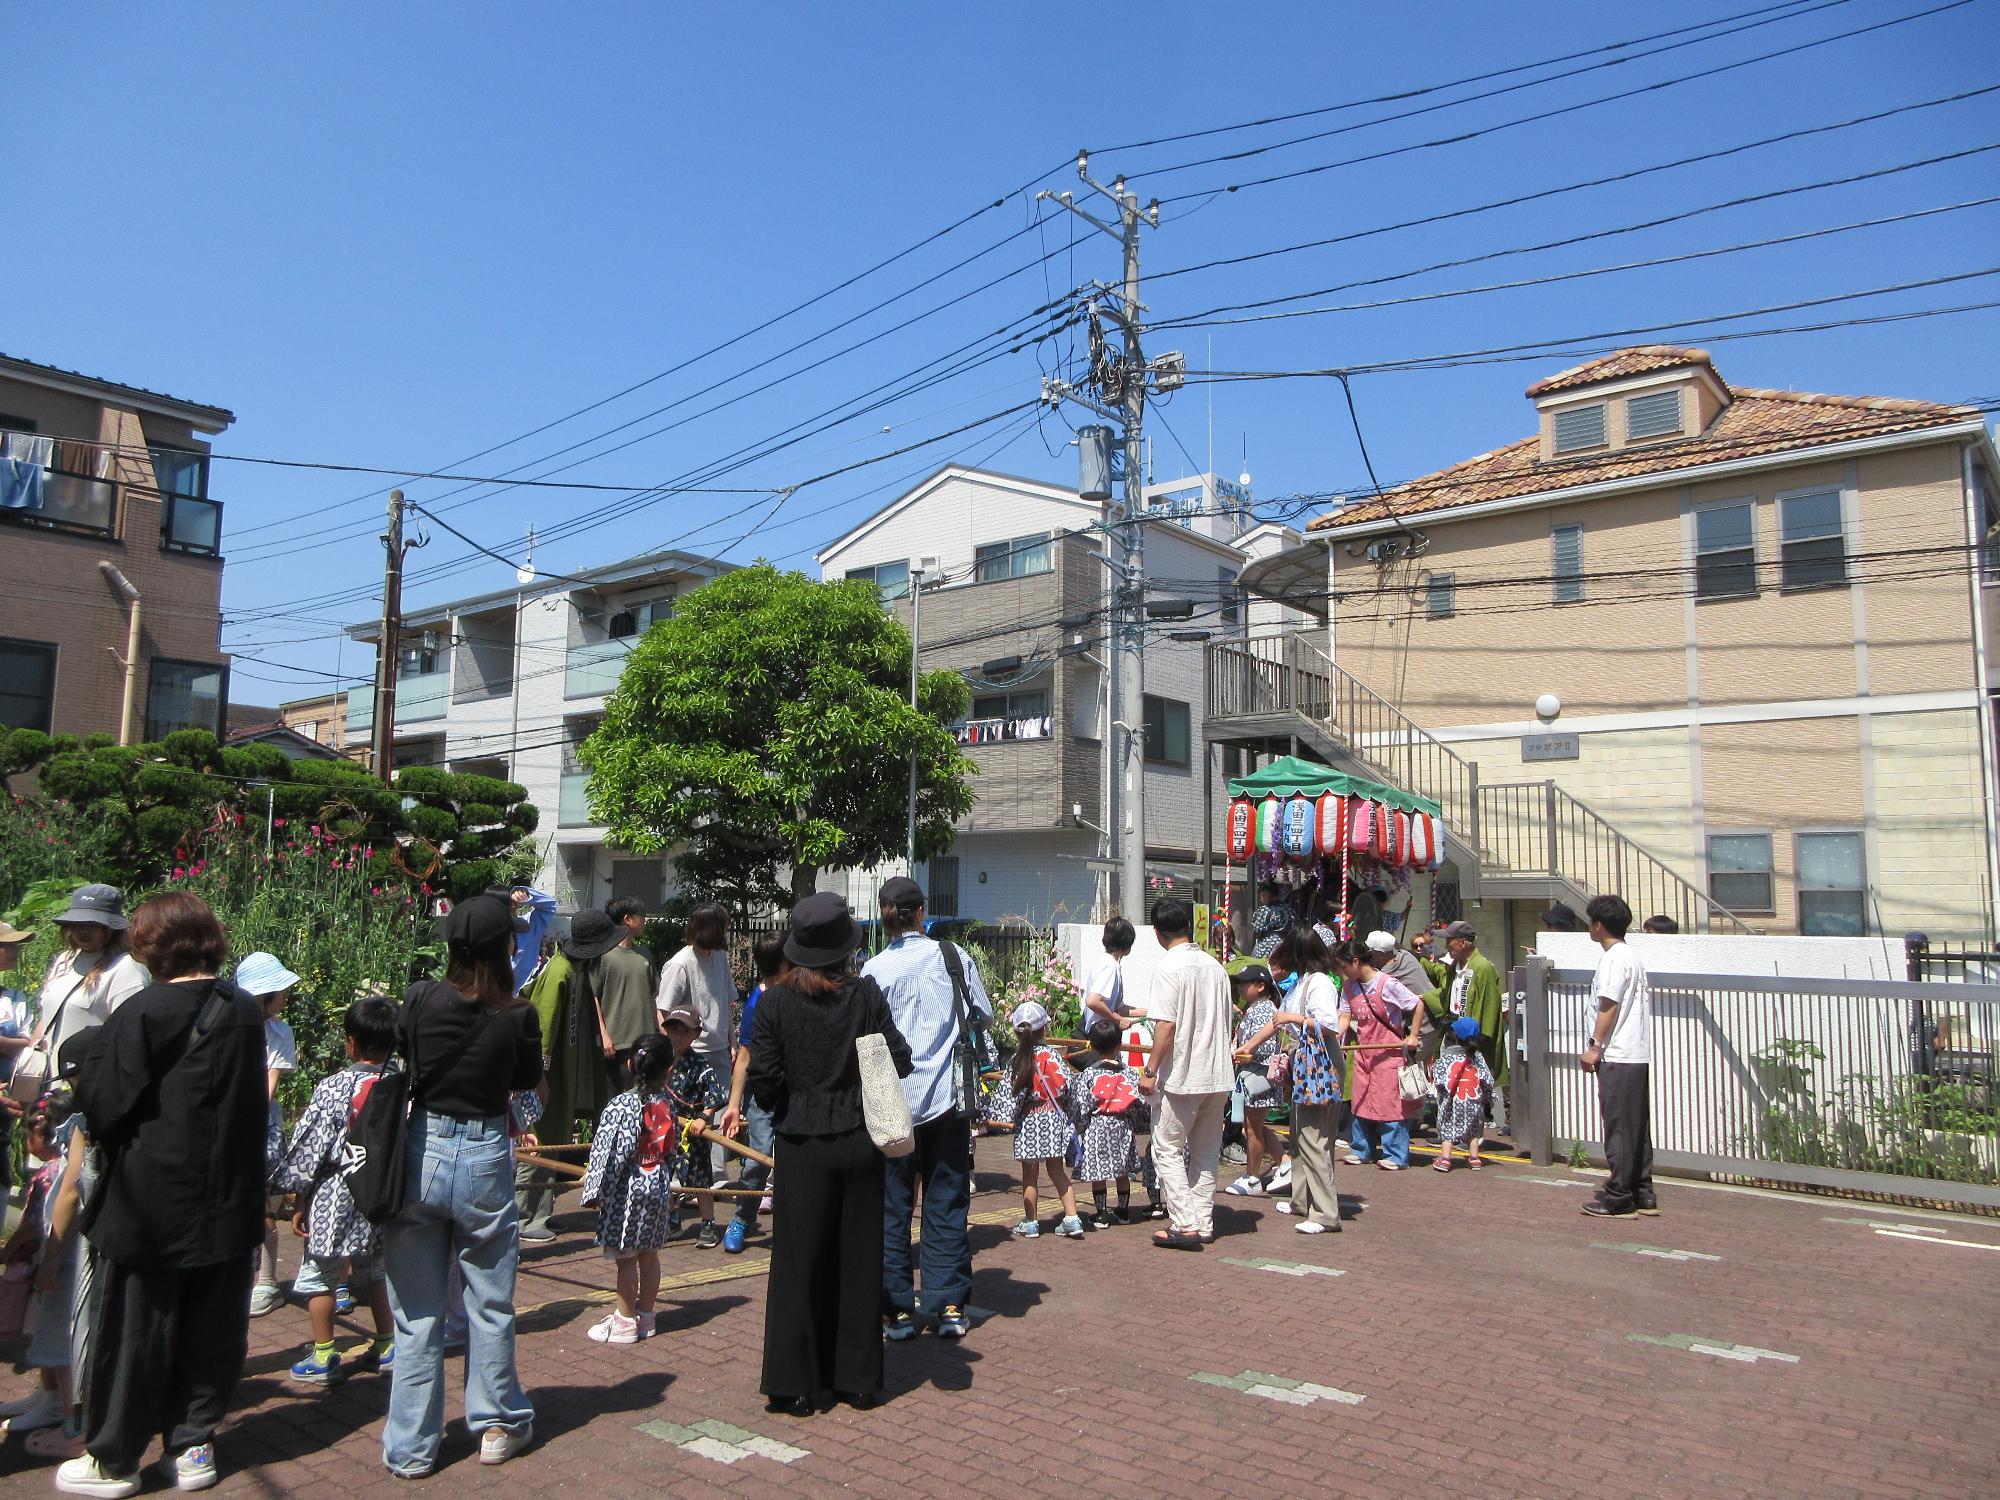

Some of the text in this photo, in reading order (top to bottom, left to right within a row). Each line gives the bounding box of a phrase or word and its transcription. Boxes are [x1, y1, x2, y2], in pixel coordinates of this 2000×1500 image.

[1292, 801, 1305, 852] 浅田三四丁目
